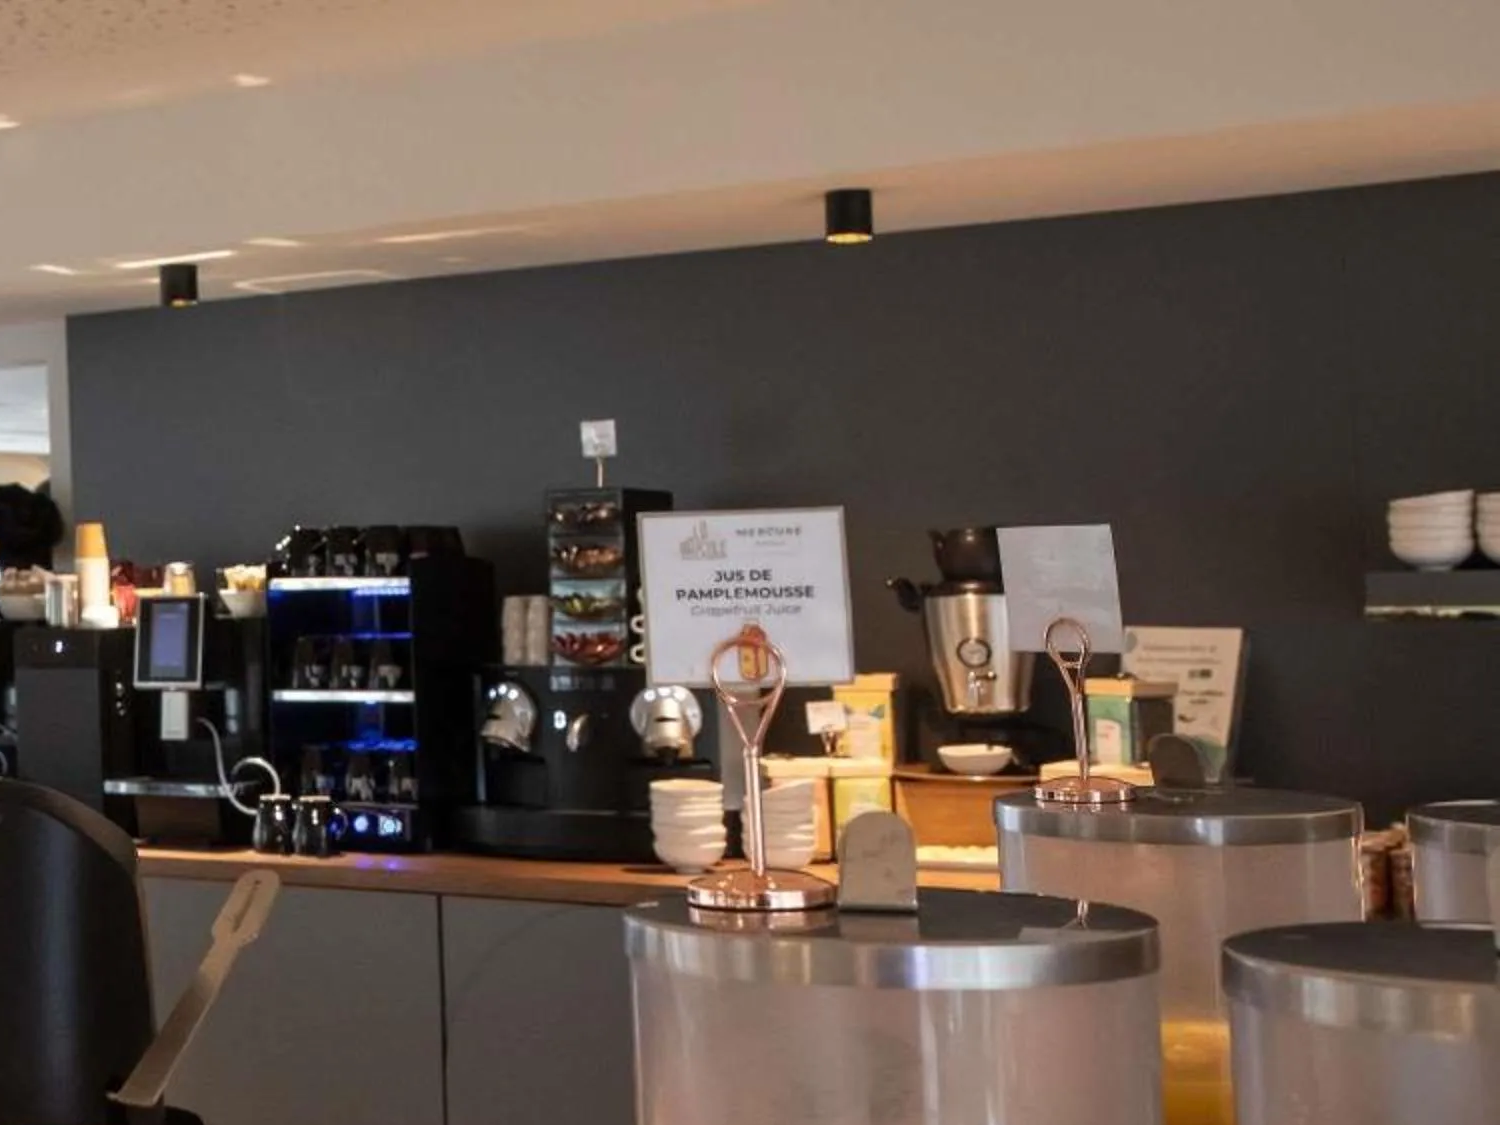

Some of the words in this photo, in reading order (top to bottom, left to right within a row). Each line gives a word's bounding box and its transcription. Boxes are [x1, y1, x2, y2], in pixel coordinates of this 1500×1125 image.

[713, 570, 745, 583] JUS
[749, 569, 772, 582] DE
[675, 585, 815, 601] PAMPLEMOUSSE
[765, 603, 802, 616] Juice
